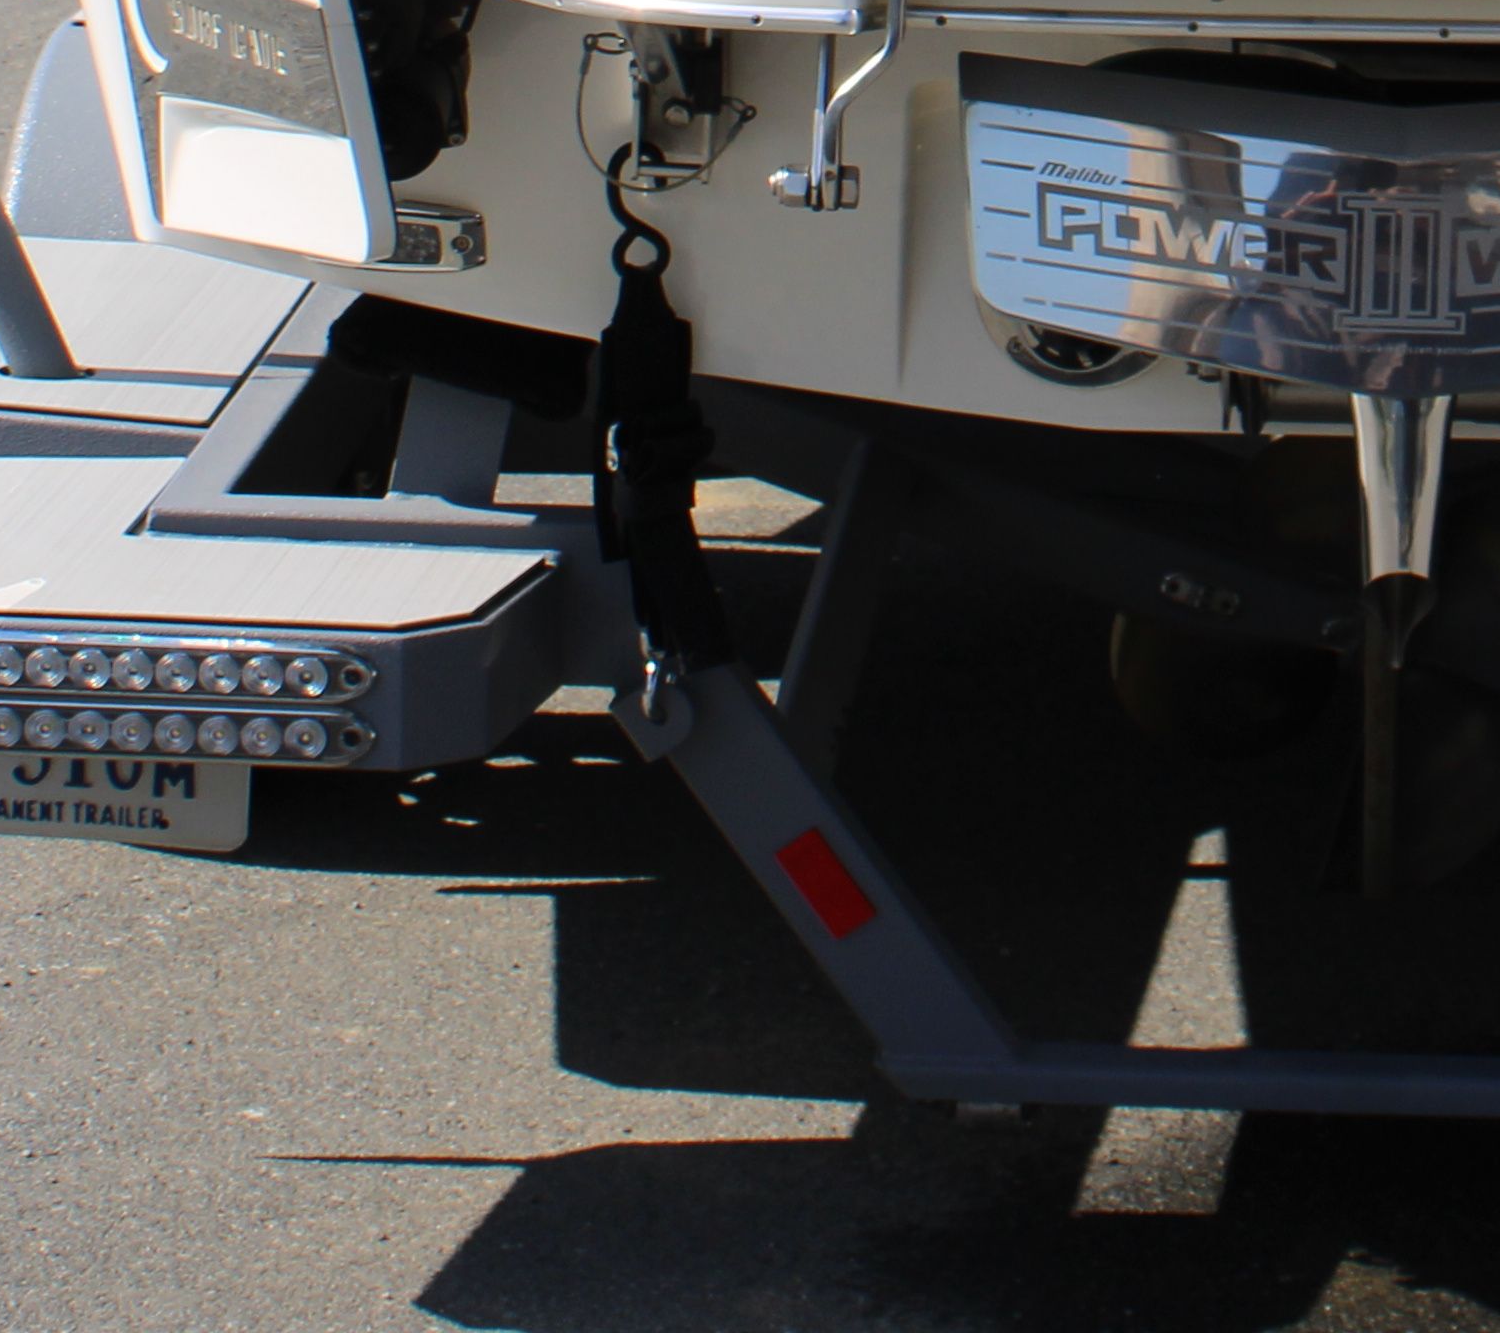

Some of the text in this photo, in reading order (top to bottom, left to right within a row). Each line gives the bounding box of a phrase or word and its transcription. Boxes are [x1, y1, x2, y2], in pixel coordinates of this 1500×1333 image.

[1039, 162, 1117, 185] Malibu
[1043, 190, 1346, 284] POWER
[73, 799, 165, 830] TRAILER
